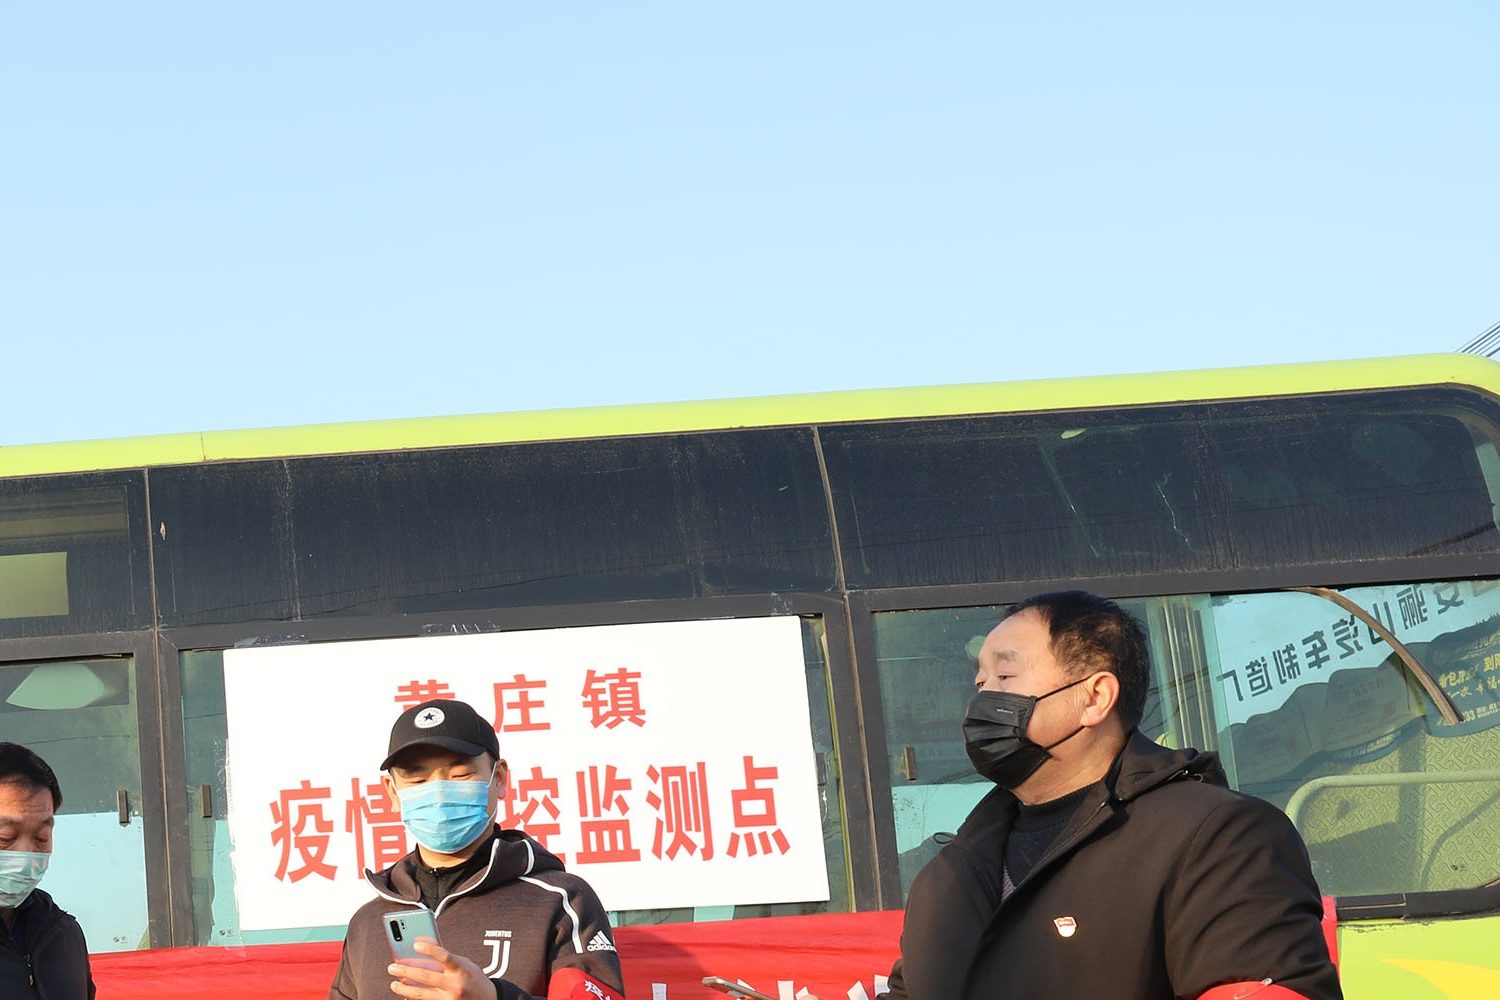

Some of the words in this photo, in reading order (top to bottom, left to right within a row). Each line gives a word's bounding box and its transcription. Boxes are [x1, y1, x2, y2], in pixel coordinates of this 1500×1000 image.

[268, 755, 792, 884] 疫情控监测点
[484, 930, 513, 938] JUVENTUS
